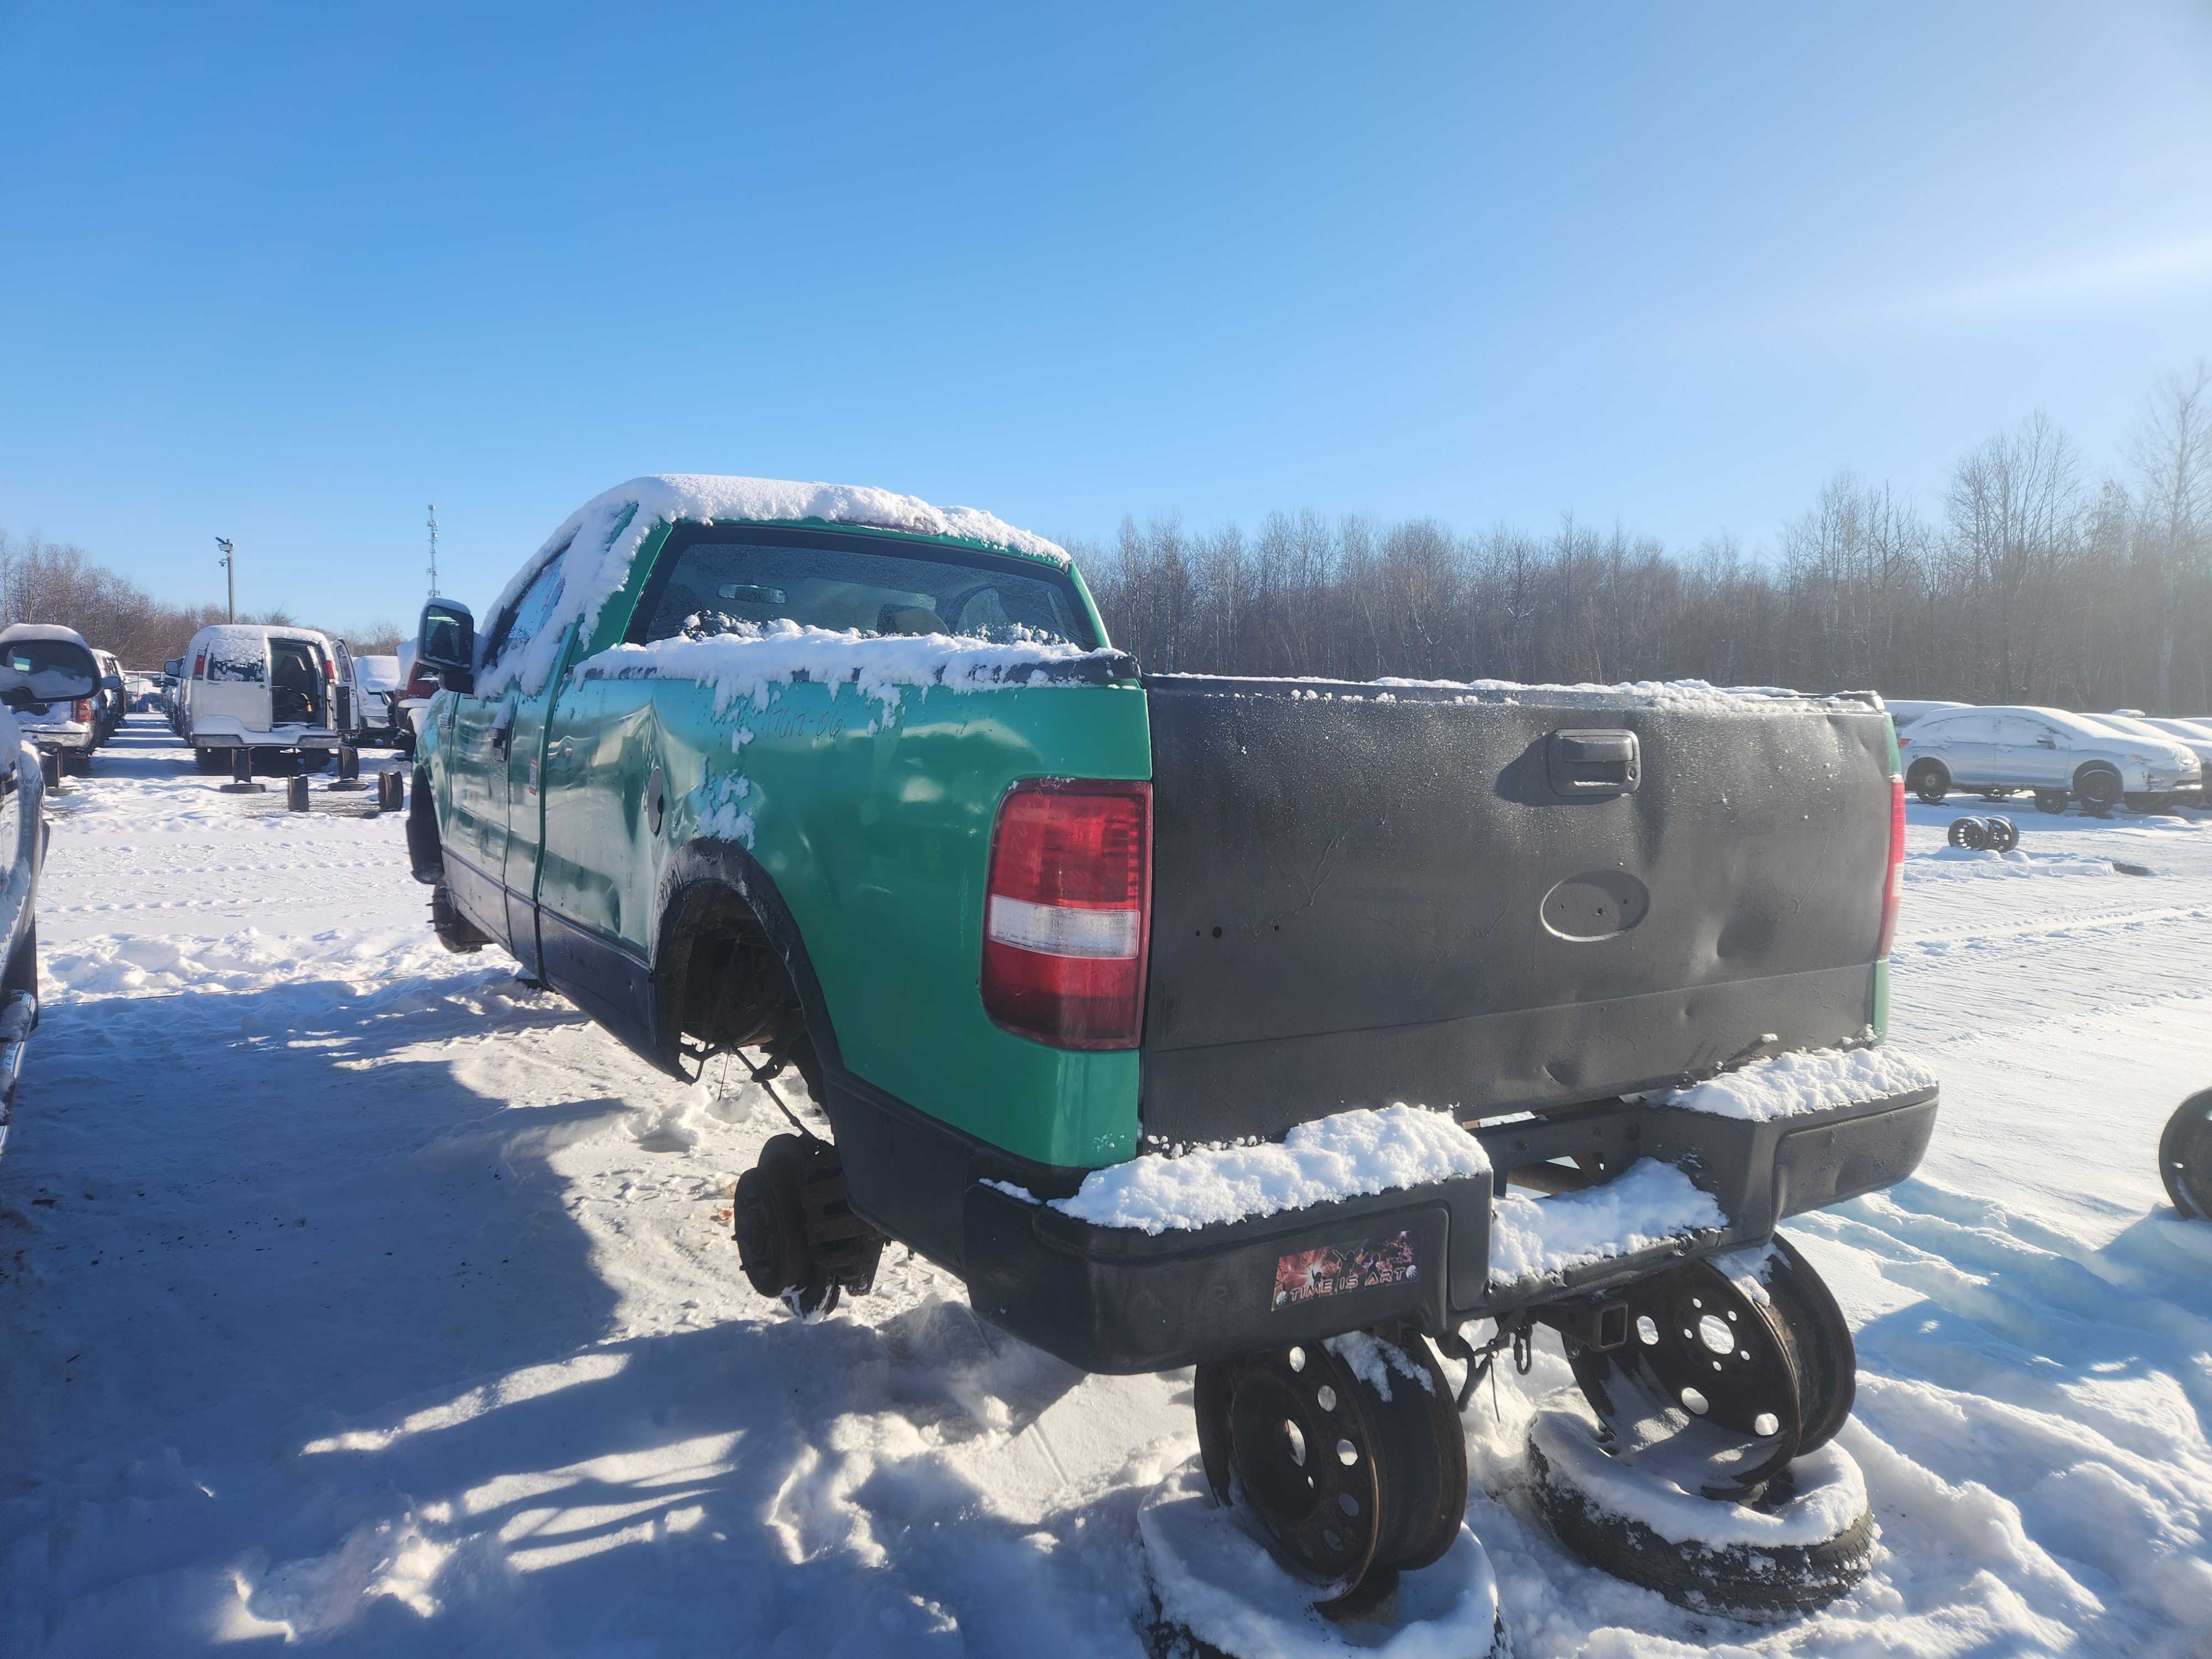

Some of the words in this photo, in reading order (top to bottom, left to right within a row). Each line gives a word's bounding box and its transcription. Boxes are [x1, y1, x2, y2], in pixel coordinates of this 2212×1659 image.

[1290, 1278, 1333, 1301] TIME
[1339, 1275, 1359, 1290] IS
[1364, 1267, 1406, 1287] ART
